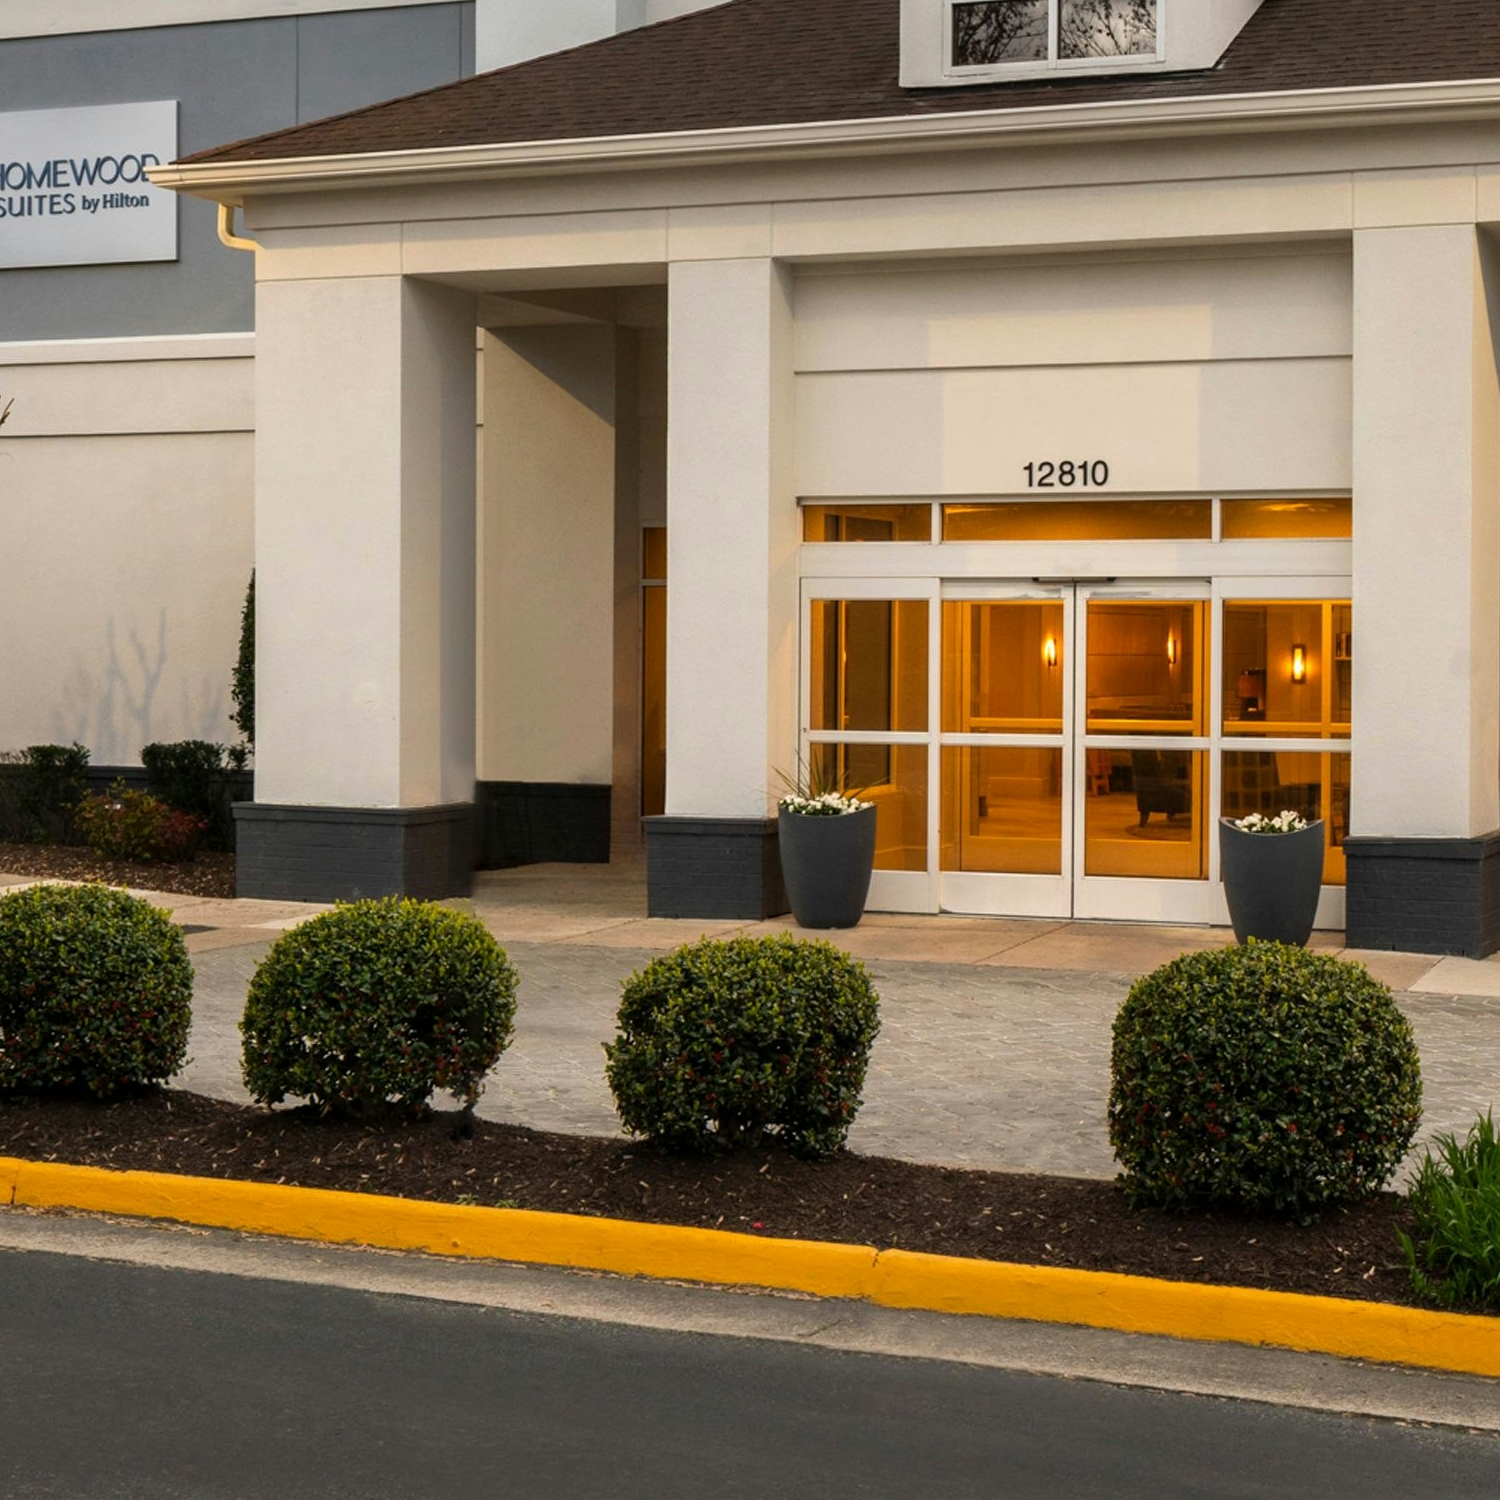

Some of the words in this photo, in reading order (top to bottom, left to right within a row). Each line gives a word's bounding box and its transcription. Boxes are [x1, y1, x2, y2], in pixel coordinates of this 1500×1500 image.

[81, 195, 100, 214] by
[102, 192, 150, 209] Hilton
[1022, 460, 1109, 487] 12810
